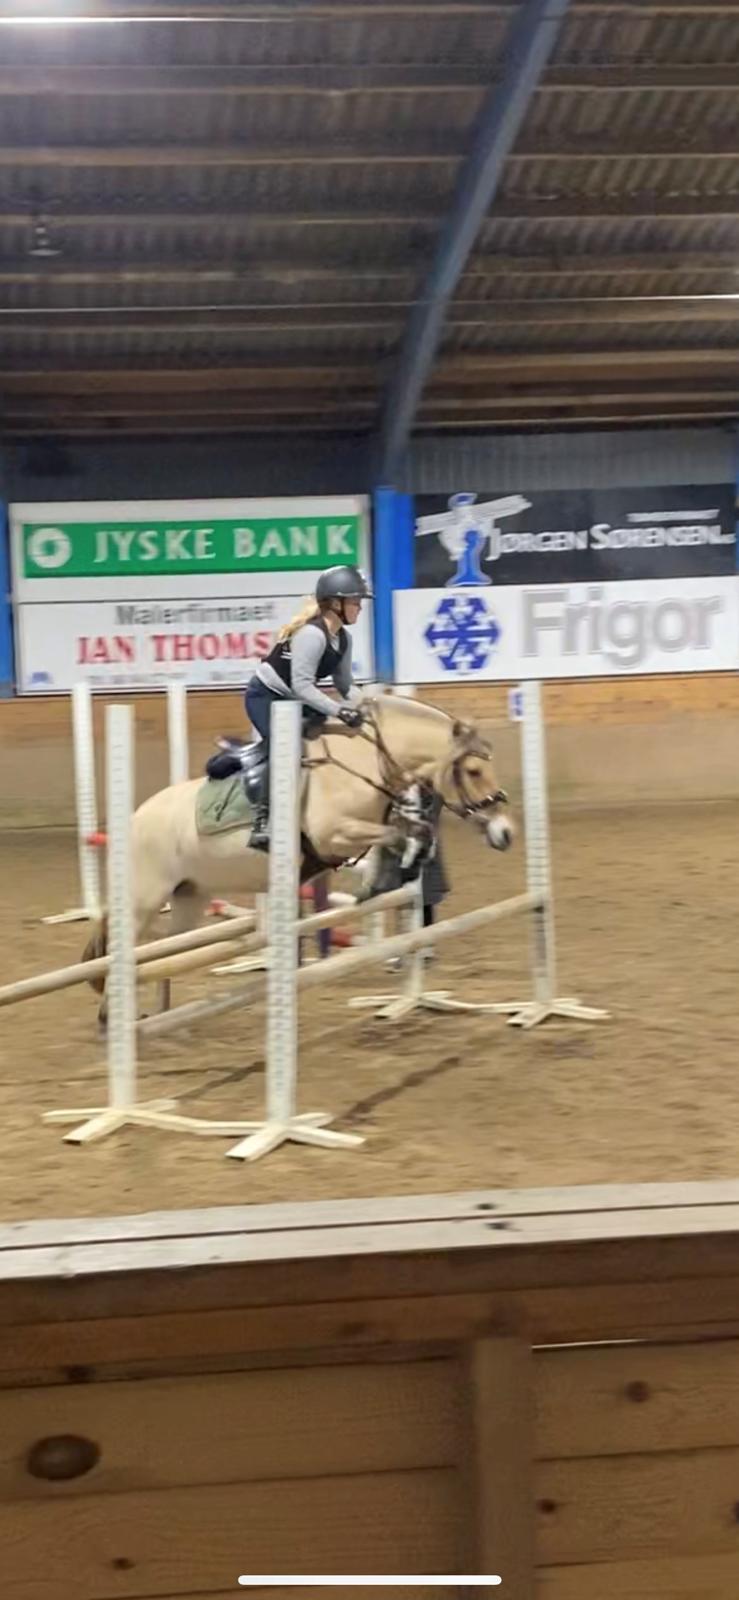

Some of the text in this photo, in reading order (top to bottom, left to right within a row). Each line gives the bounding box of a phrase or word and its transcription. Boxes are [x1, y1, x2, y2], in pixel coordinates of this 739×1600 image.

[93, 525, 353, 563] JYSKE BANK
[520, 585, 723, 669] Frigor
[77, 631, 272, 664] JAN THOMS
